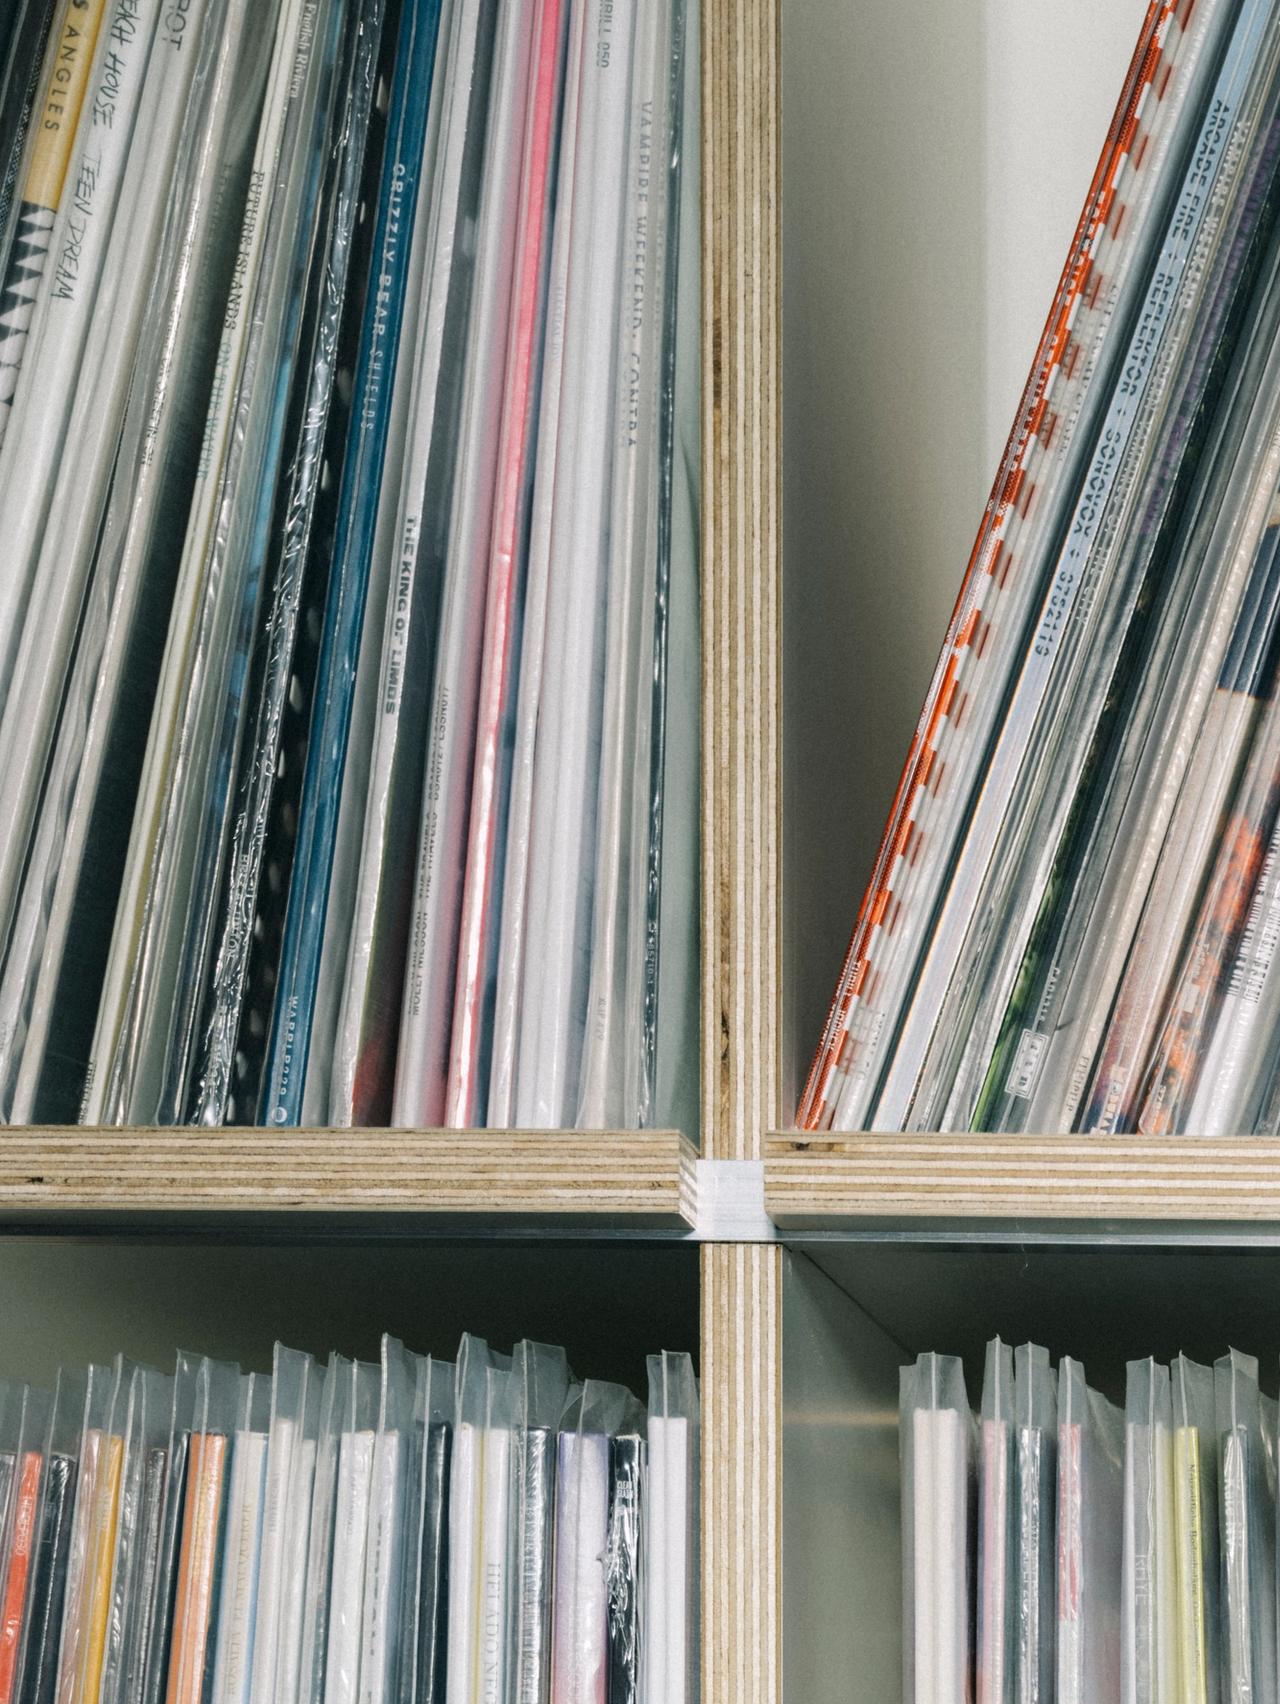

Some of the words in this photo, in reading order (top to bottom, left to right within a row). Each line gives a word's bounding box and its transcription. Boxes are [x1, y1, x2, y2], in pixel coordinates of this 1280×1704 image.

[296, 1, 317, 50] English
[44, 24, 82, 134] ANGLES
[92, 53, 126, 129] HOUSE
[288, 53, 310, 99] Riviera
[1187, 98, 1231, 185] ARCADE
[73, 155, 104, 217] TEEN
[240, 170, 266, 246] FUTURE
[382, 163, 405, 263] GRIZZLY
[1171, 192, 1205, 240] FIRE
[51, 220, 87, 300] DREAM
[224, 251, 250, 330] ISLANDS
[371, 273, 392, 336] BEAR
[1119, 272, 1174, 398] REFLEKTOR
[360, 351, 382, 430] SHIELDS
[1072, 428, 1121, 537] SONOVOX
[403, 516, 418, 555] THE
[395, 560, 413, 612] KING
